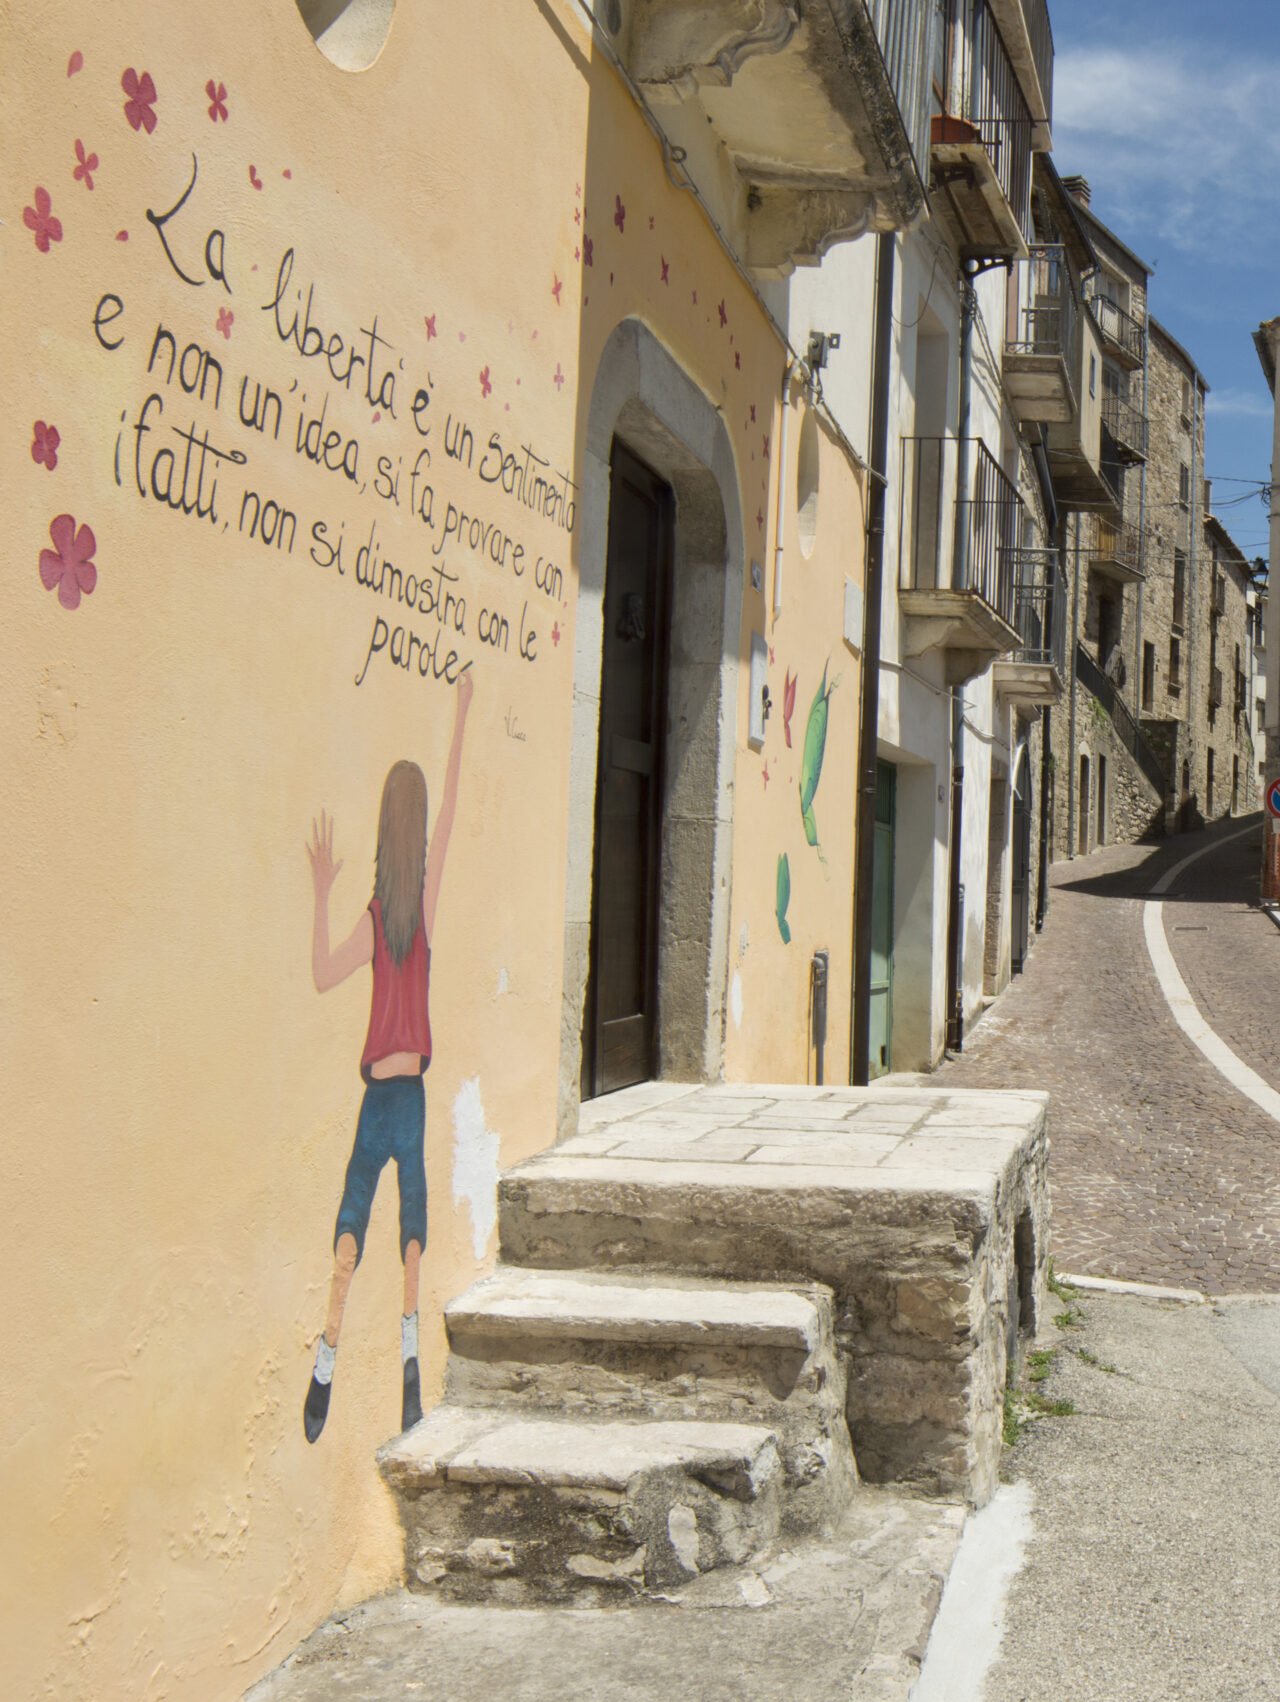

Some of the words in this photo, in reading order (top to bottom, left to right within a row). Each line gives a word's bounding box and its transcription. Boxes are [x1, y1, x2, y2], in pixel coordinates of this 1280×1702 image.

[92, 293, 125, 350] e
[147, 323, 223, 410] non
[410, 448, 435, 529] fa
[432, 502, 525, 576] provare
[535, 556, 563, 602] con
[146, 152, 232, 294] La
[444, 413, 473, 469] un
[114, 409, 127, 486] i
[238, 490, 297, 554] non
[356, 519, 466, 636] dimostra
[478, 608, 509, 652] con
[519, 600, 537, 661] le
[354, 615, 459, 687] parole
